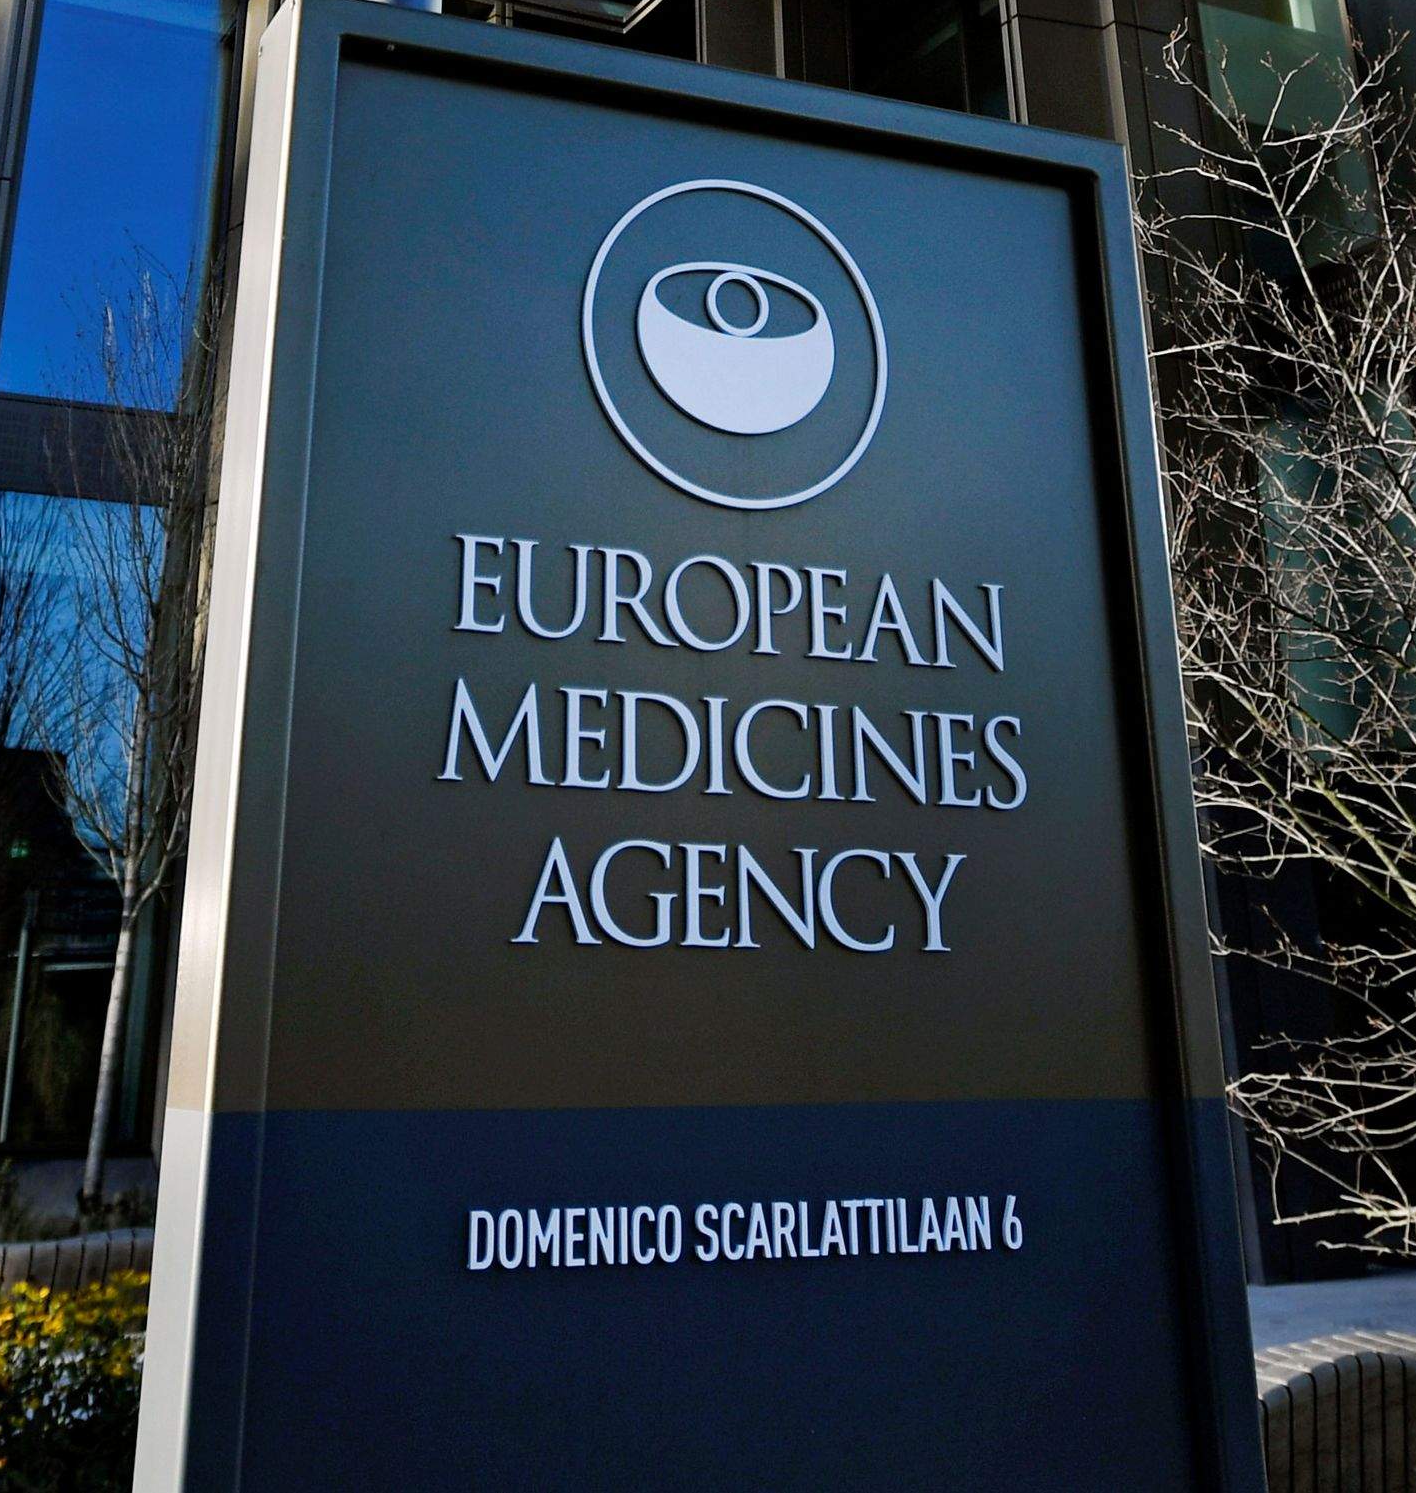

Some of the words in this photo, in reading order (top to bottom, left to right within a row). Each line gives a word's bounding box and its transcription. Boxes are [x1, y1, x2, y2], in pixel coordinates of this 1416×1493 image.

[454, 534, 1004, 671] EUROPEAN
[438, 678, 1027, 809] MEDICINES
[511, 837, 967, 952] AGENCY
[468, 1204, 682, 1269] DOMENICO
[695, 1197, 992, 1259] SCARLATTILAAN
[1002, 1195, 1023, 1250] 6
